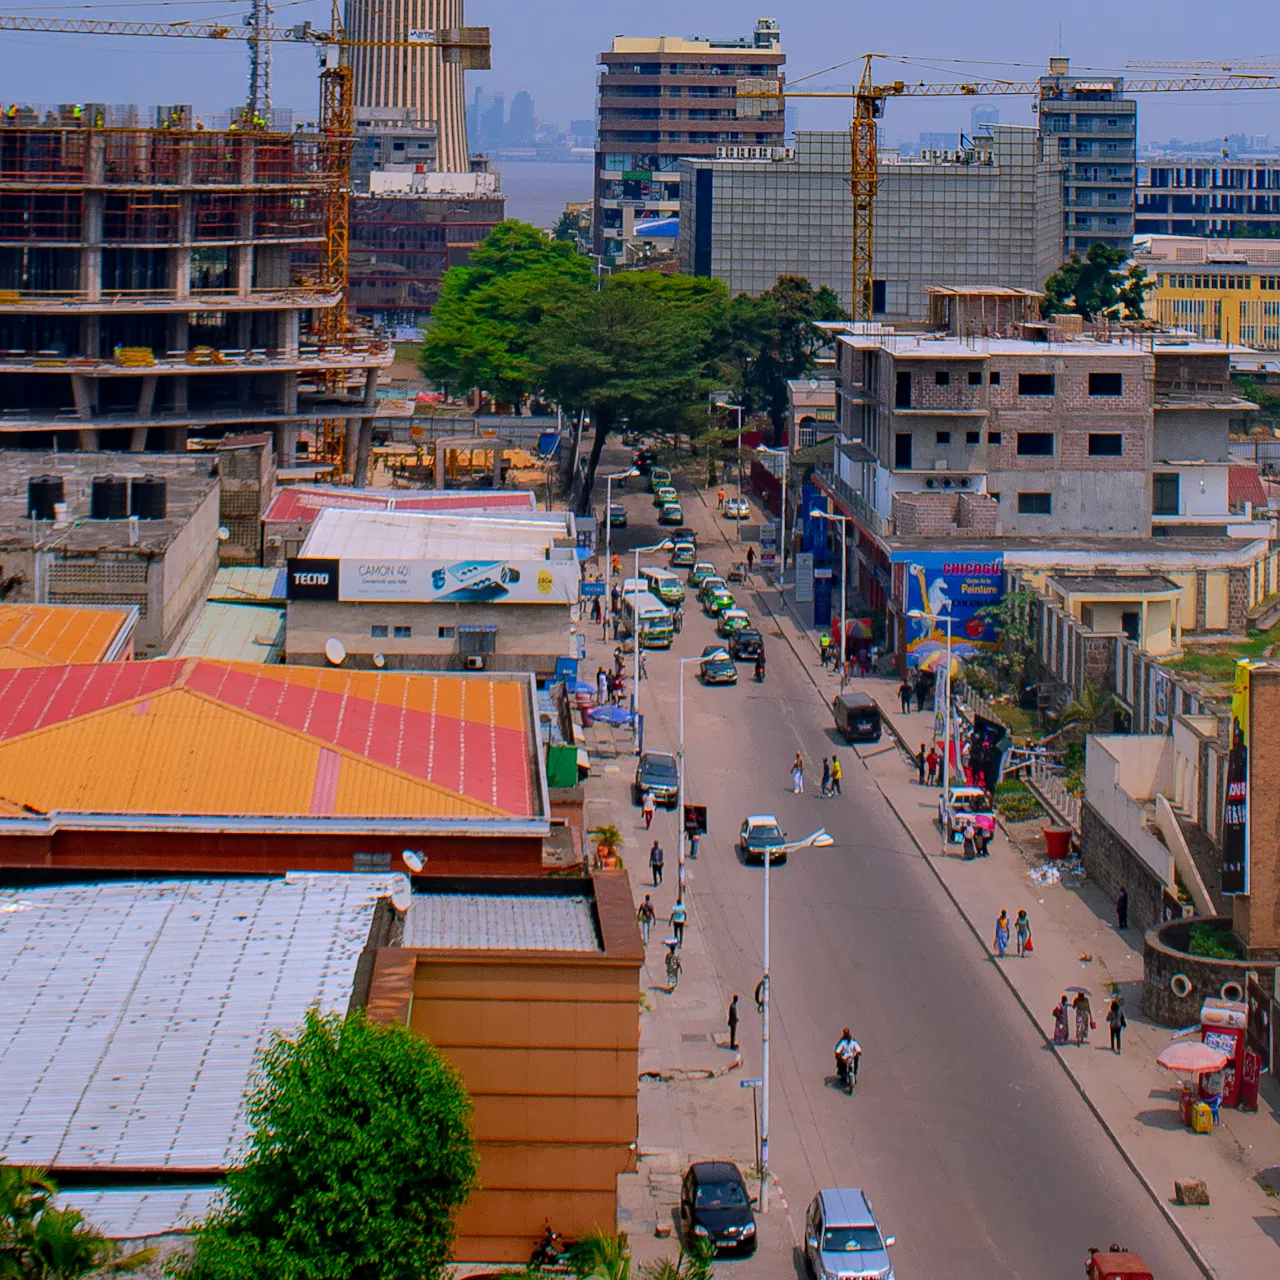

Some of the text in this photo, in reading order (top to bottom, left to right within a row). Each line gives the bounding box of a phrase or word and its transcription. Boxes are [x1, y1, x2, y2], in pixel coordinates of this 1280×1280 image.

[358, 564, 394, 577] CAMON
[943, 563, 1000, 576] CHICAGO
[293, 572, 329, 586] TECNO
[961, 583, 998, 594] Peinture
